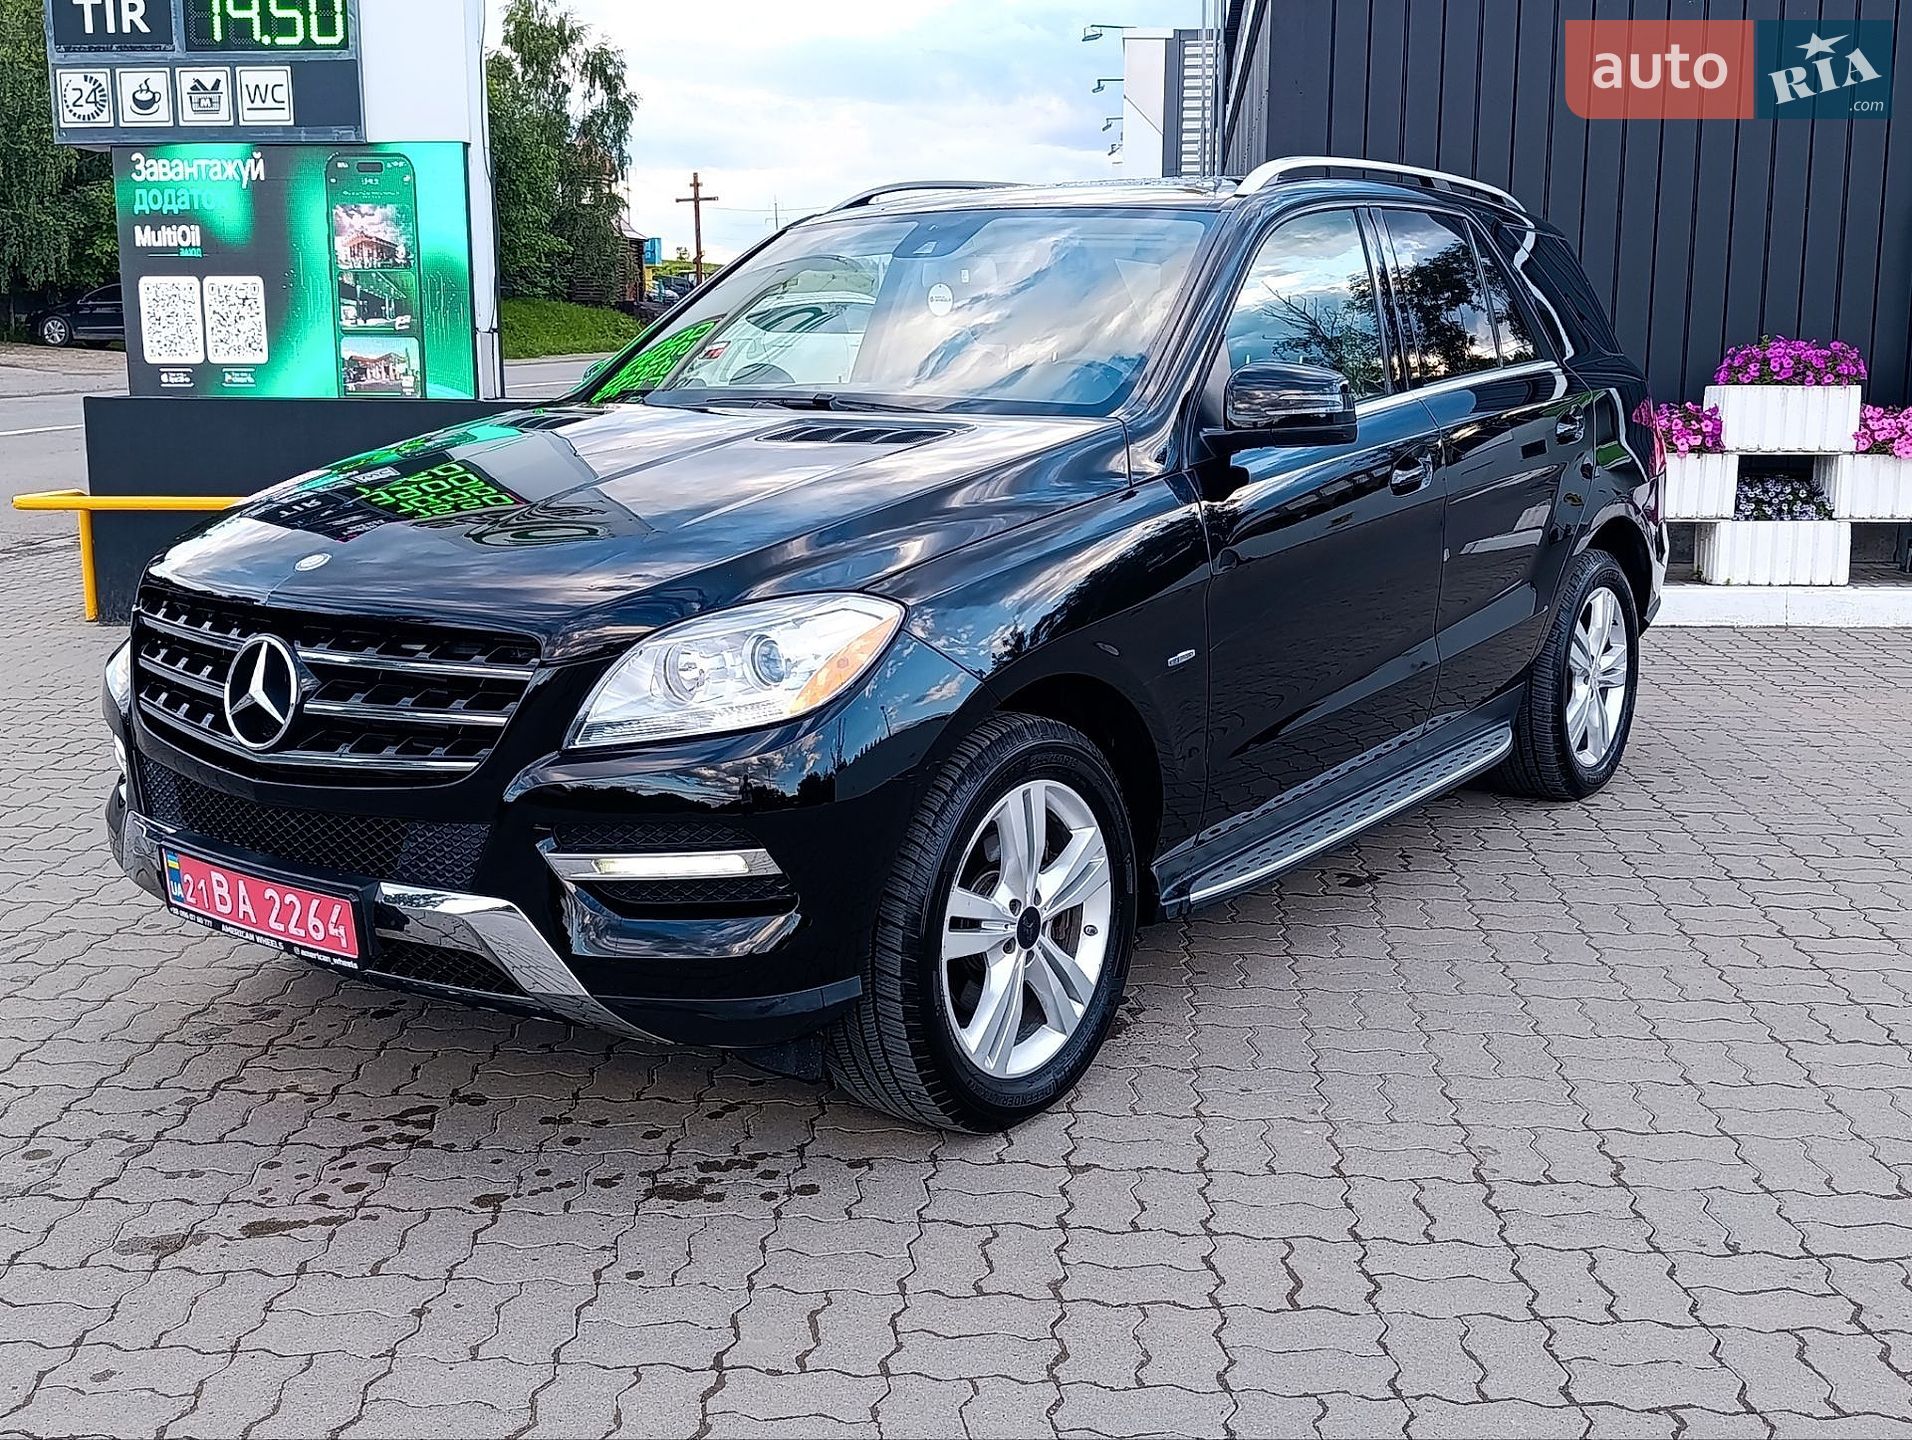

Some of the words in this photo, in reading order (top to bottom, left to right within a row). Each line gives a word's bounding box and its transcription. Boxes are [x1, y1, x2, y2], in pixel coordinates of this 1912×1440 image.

[71, 0, 150, 33] TIR
[71, 88, 100, 107] 24
[245, 83, 285, 104] WC
[130, 151, 265, 189] Завантажуй
[134, 224, 201, 247] MultiOil
[170, 880, 184, 898] UA
[264, 888, 347, 948] 2264
[221, 923, 255, 942] AMERICAN
[255, 934, 284, 950] WHEELS
